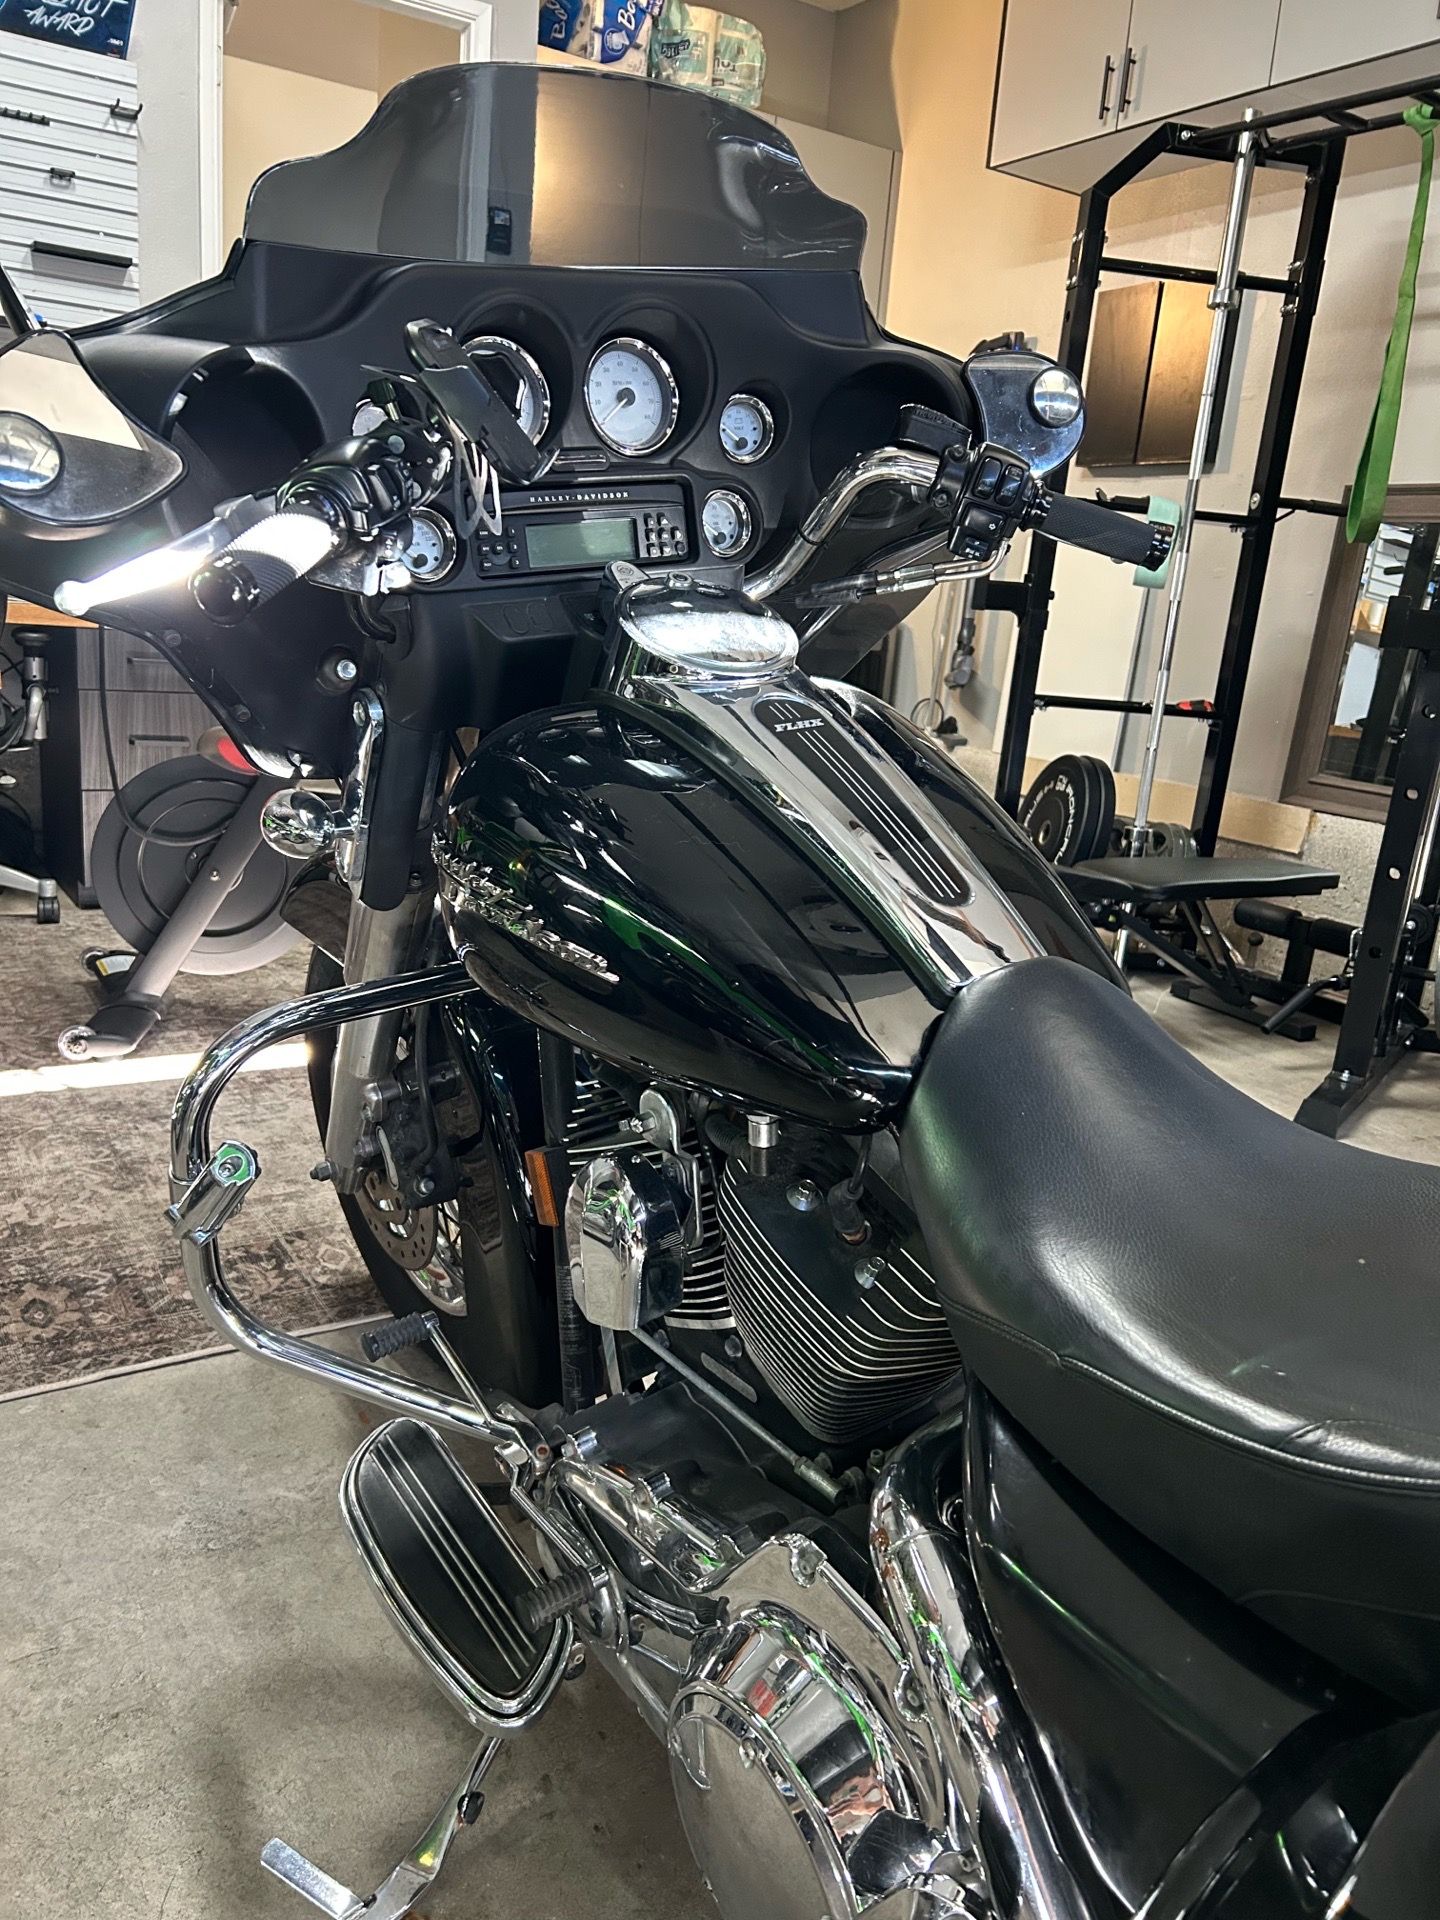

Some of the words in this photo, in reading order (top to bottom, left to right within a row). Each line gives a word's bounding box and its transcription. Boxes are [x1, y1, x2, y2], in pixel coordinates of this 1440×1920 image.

[23, 5, 95, 37] AWARD
[529, 491, 629, 503] HARLEY-DAVIDSON
[773, 718, 825, 733] FLHX
